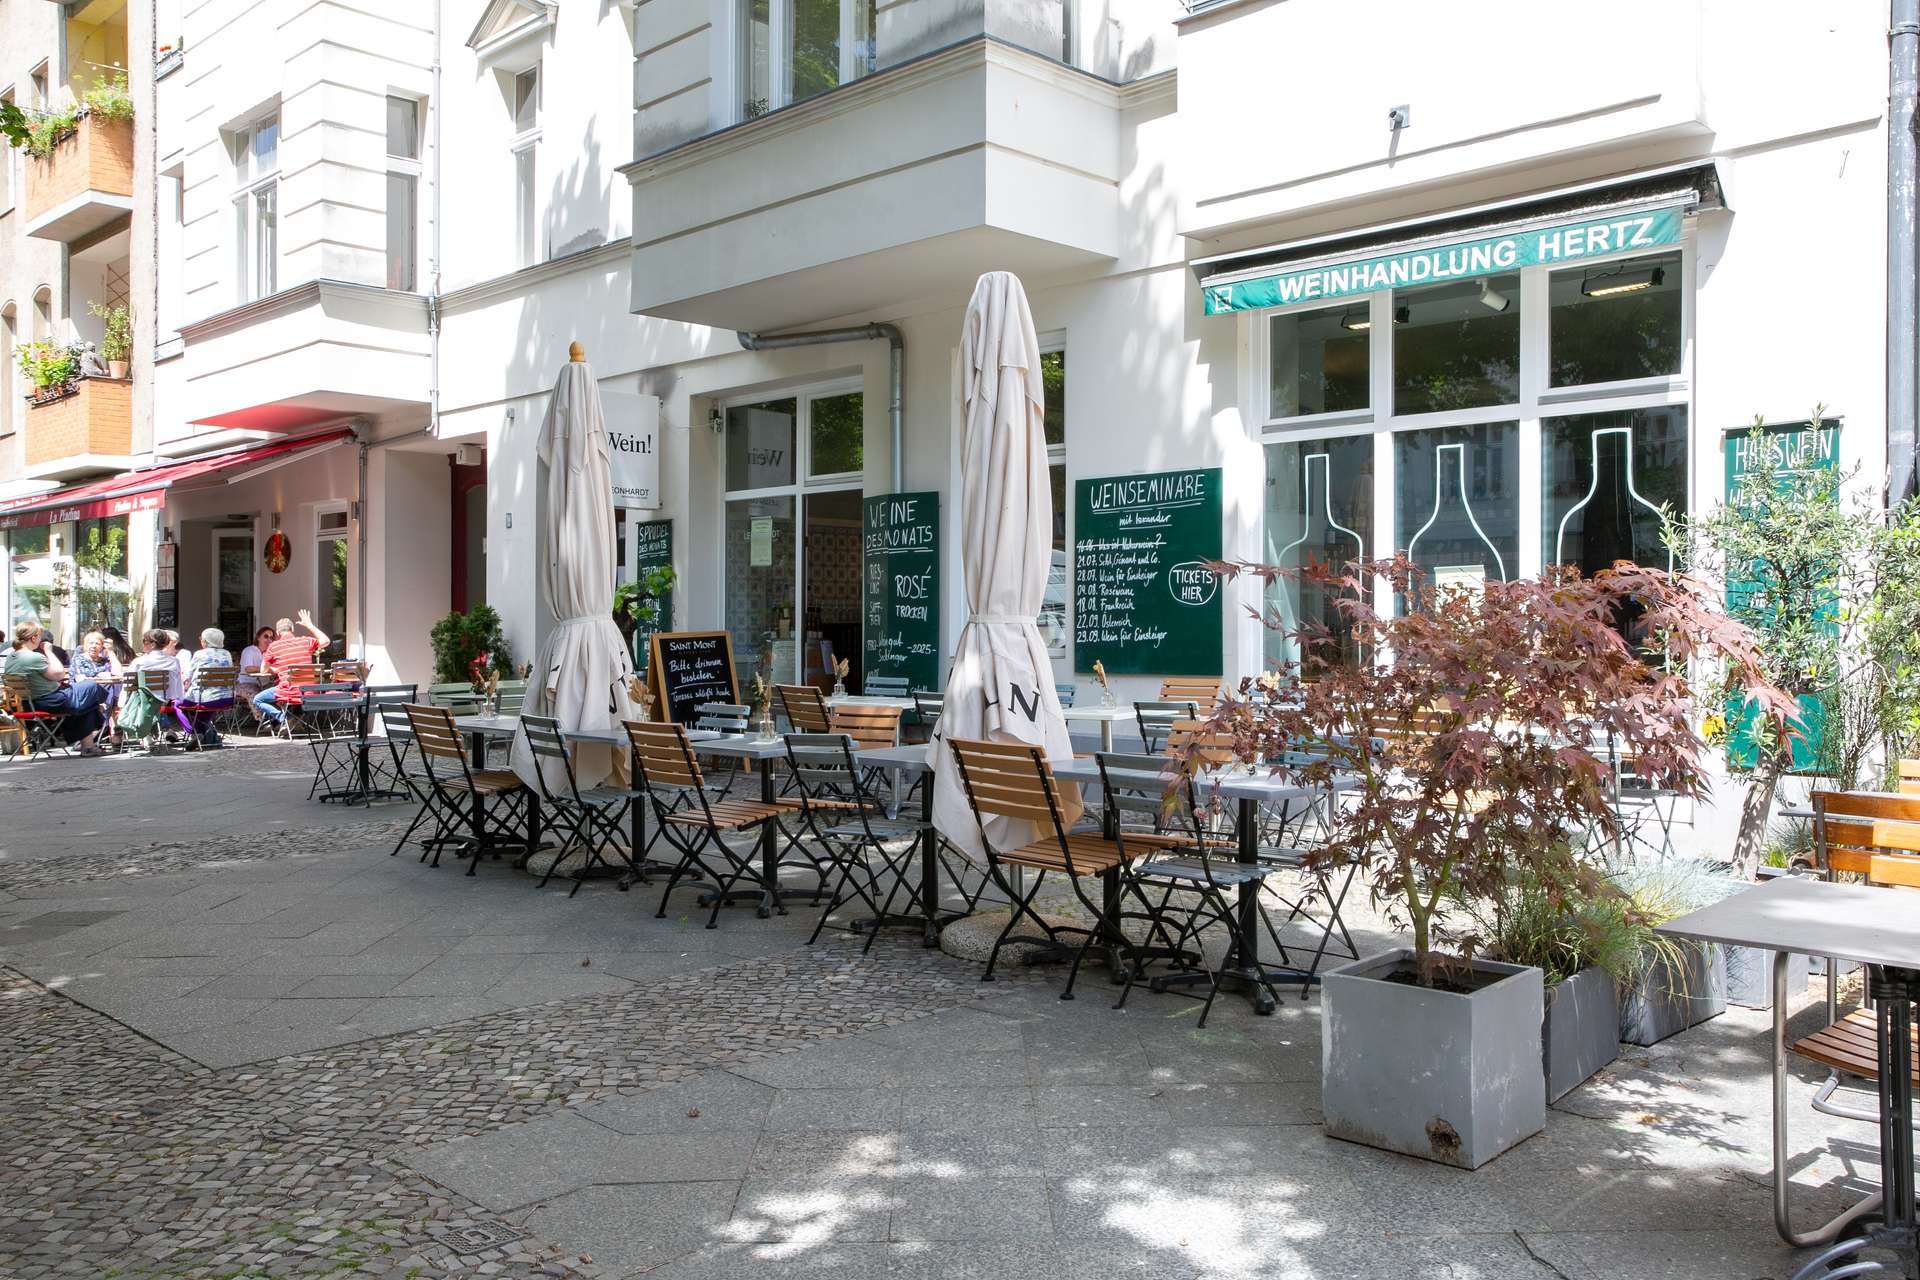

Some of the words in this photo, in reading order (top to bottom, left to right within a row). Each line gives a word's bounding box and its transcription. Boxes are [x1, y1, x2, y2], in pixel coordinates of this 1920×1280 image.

[1279, 239, 1516, 301] WEINHANDLUNG
[1538, 217, 1654, 260] HERTZ
[608, 432, 652, 454] Wein!
[611, 486, 650, 496] EONHARDT
[1090, 474, 1205, 508] WEINSEMINARE
[869, 500, 918, 528] WEINE
[1119, 512, 1132, 526] mit
[866, 532, 882, 549] DES
[883, 525, 933, 546] MONATS
[894, 565, 931, 599] ROSÉ
[1172, 569, 1213, 585] TICKETS
[1180, 586, 1203, 602] HIER
[668, 658, 690, 673] Bitte
[1008, 682, 1041, 723] N
